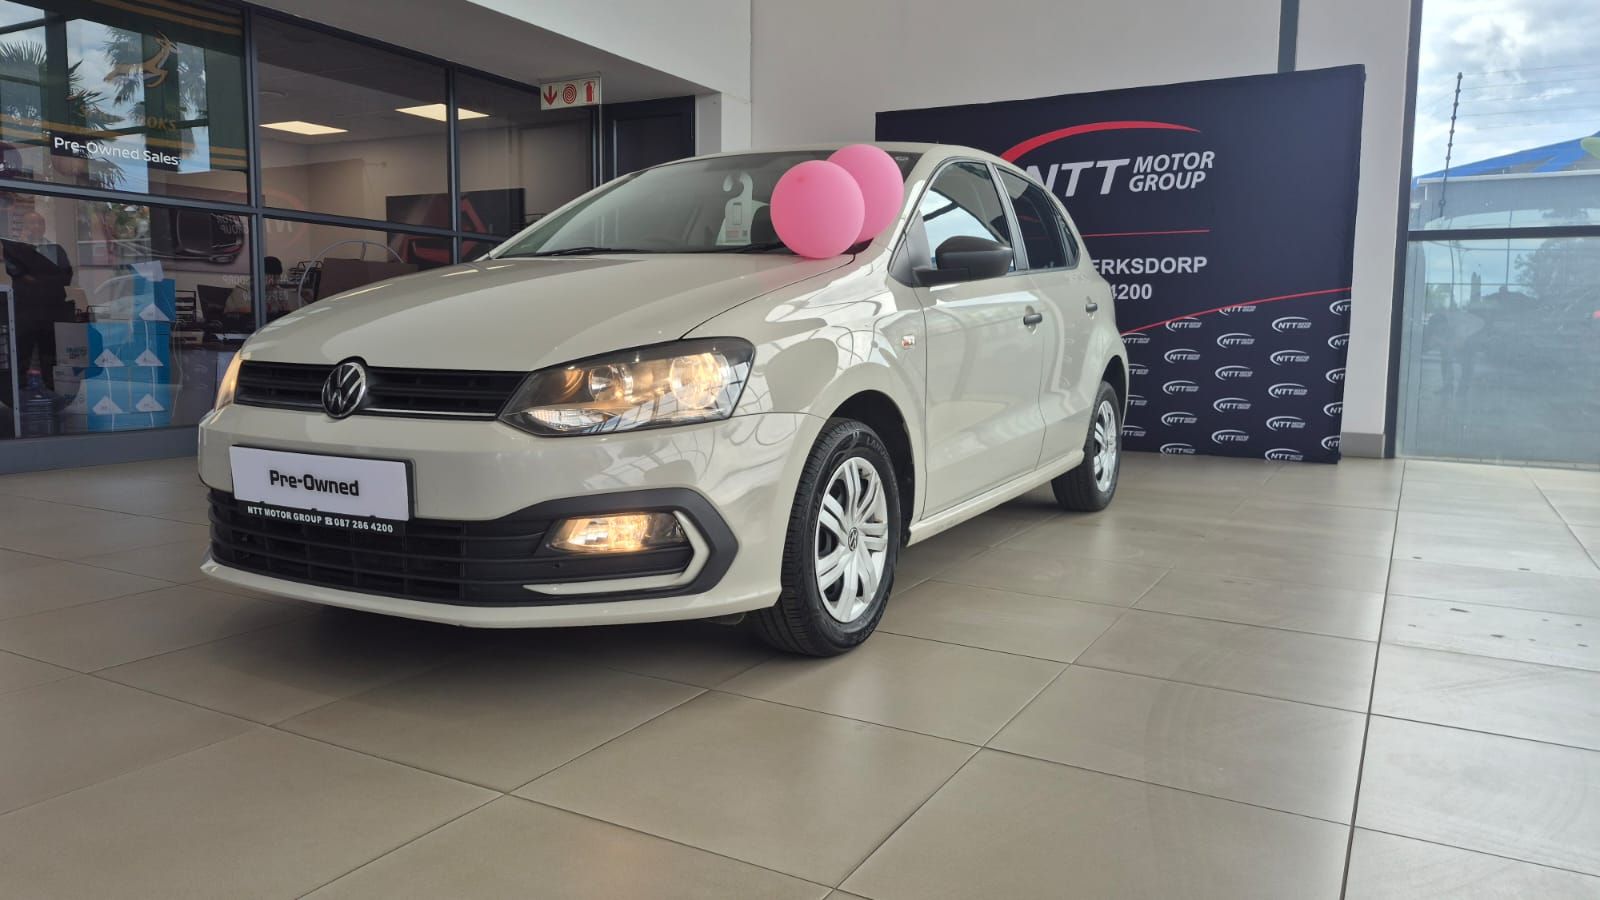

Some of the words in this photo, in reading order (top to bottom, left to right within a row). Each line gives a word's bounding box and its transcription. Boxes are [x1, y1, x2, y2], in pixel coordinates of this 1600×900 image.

[54, 137, 140, 160] Pre-Owned
[143, 150, 179, 166] Sales
[1024, 158, 1131, 197] NTT
[1133, 150, 1216, 174] MOTOR
[1129, 171, 1206, 192] GROUP
[269, 470, 360, 496] Pre-Owned
[247, 506, 262, 515] NTT
[264, 508, 292, 519] MOTOR
[293, 513, 322, 524] GROUP
[334, 518, 350, 528] 087
[352, 520, 369, 530] 286
[371, 523, 394, 533] 4200
